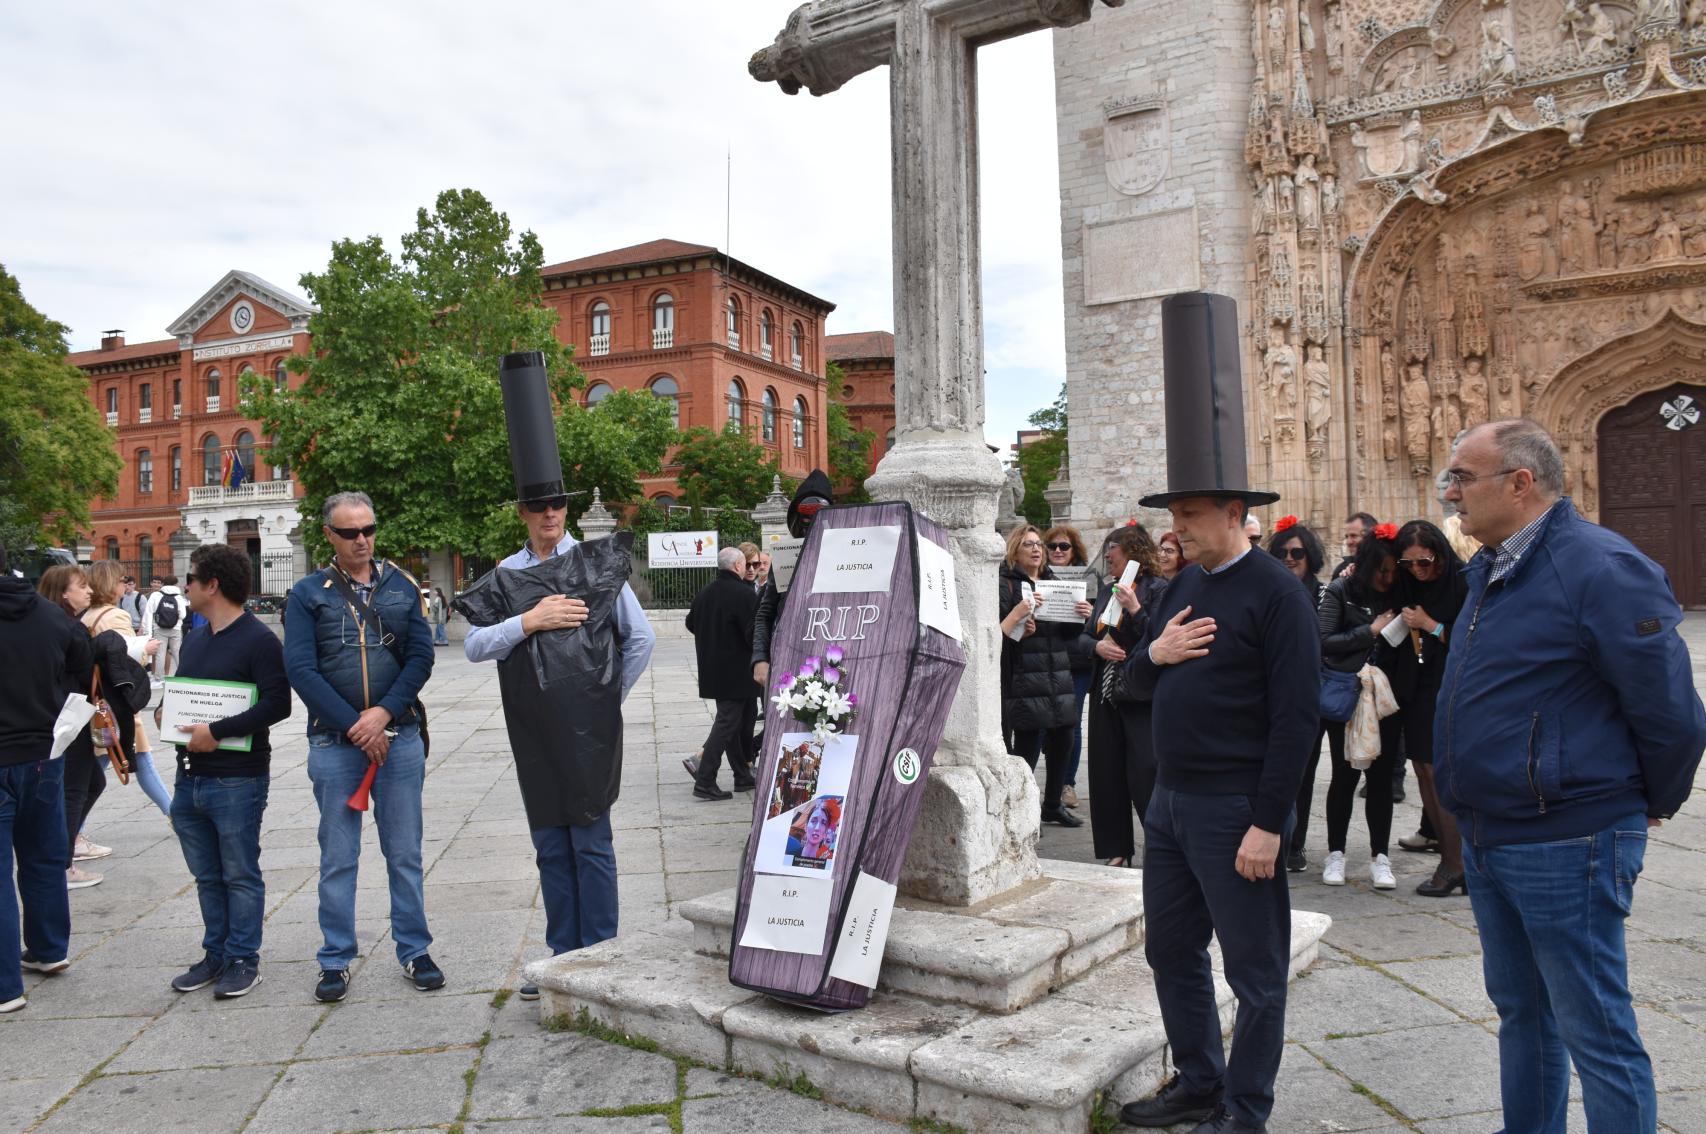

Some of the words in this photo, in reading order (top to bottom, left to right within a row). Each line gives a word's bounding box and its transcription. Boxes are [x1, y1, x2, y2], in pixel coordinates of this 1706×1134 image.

[200, 345, 240, 357] INSTITUTO
[245, 338, 286, 352] ZORRILLA
[845, 563, 873, 571] JUSTICIA
[802, 604, 880, 641] RIP
[902, 750, 911, 774] CSIF
[782, 889, 799, 898] R.I.P.
[767, 916, 776, 924] LA
[776, 917, 805, 927] JUSTICIA
[849, 916, 859, 937] R.I.P.
[861, 944, 869, 956] LA
[865, 908, 878, 945] JUSTICIA
